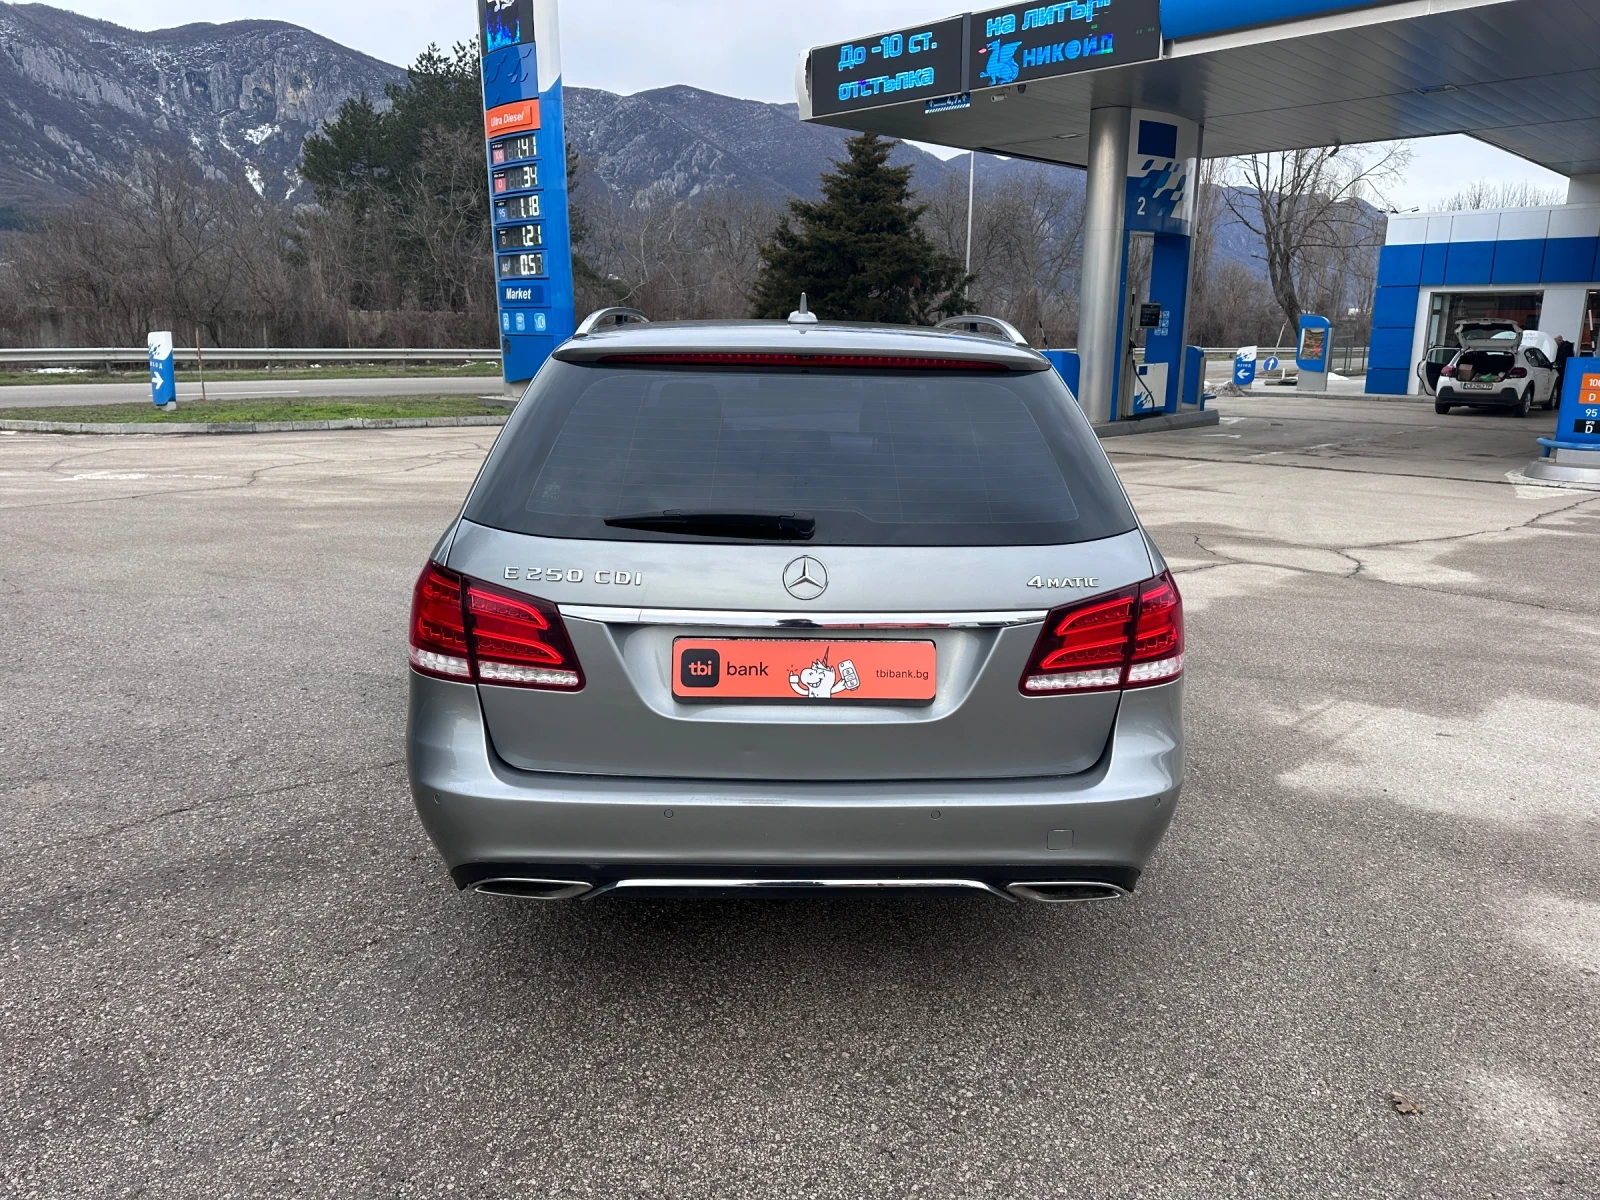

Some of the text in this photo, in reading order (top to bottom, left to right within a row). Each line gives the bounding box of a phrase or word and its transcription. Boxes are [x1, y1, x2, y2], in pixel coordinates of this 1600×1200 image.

[986, 14, 1016, 37] на
[838, 31, 938, 71] До -10 ст.
[838, 67, 935, 101] отстъпка
[490, 111, 525, 127] Ultra Diesel
[1136, 196, 1146, 215] 2
[505, 288, 532, 300] Market
[1588, 393, 1597, 402] D
[1585, 408, 1598, 418] 95
[1584, 424, 1594, 434] D
[503, 566, 643, 586] E 250 CDI
[688, 660, 930, 681] tbi bank tbibank.bg
